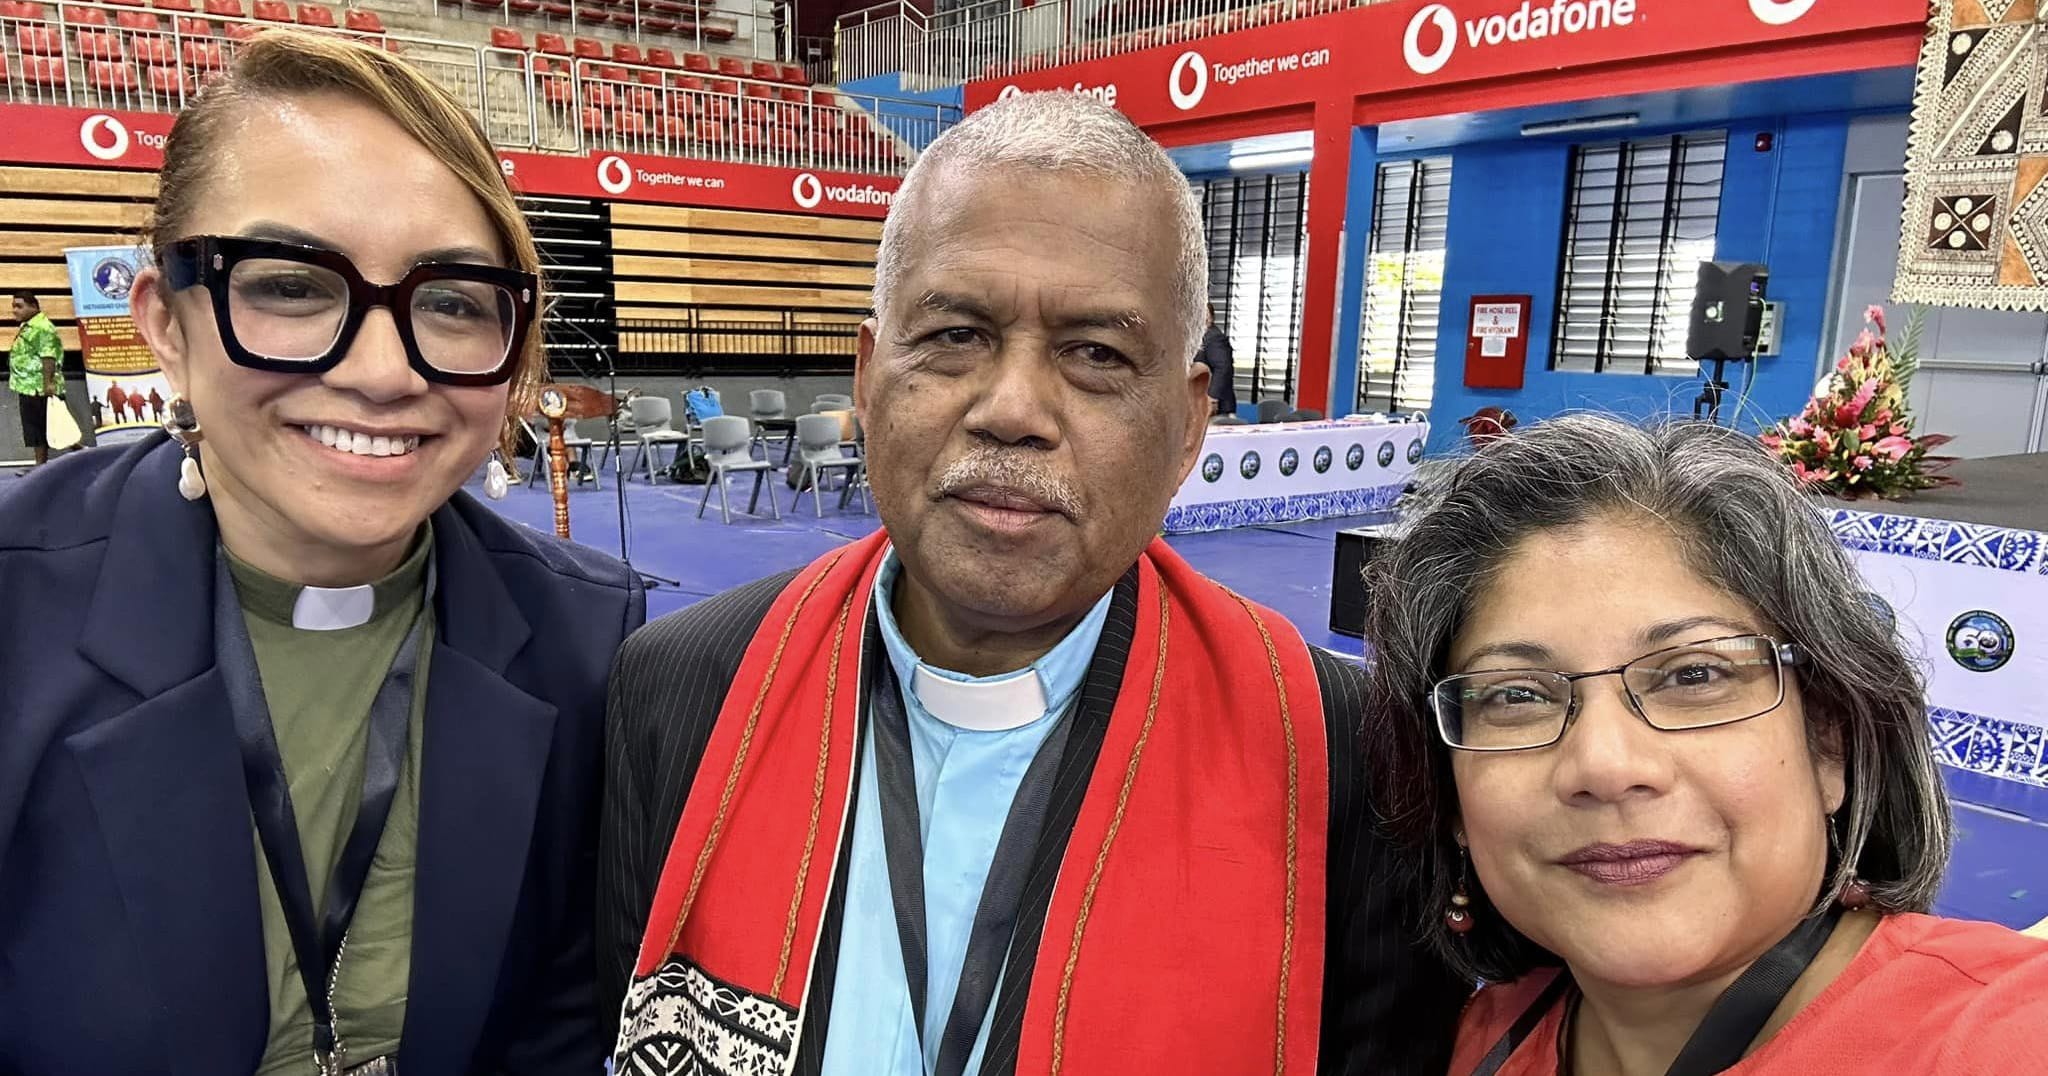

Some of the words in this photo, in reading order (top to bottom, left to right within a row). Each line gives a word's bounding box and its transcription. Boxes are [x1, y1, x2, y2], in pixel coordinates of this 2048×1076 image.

[1464, 0, 1637, 48] vodafone
[1212, 57, 1276, 85] Together
[1277, 54, 1299, 72] we
[1301, 48, 1330, 68] can
[636, 169, 686, 186] Together
[686, 175, 703, 187] we
[704, 178, 725, 189] can
